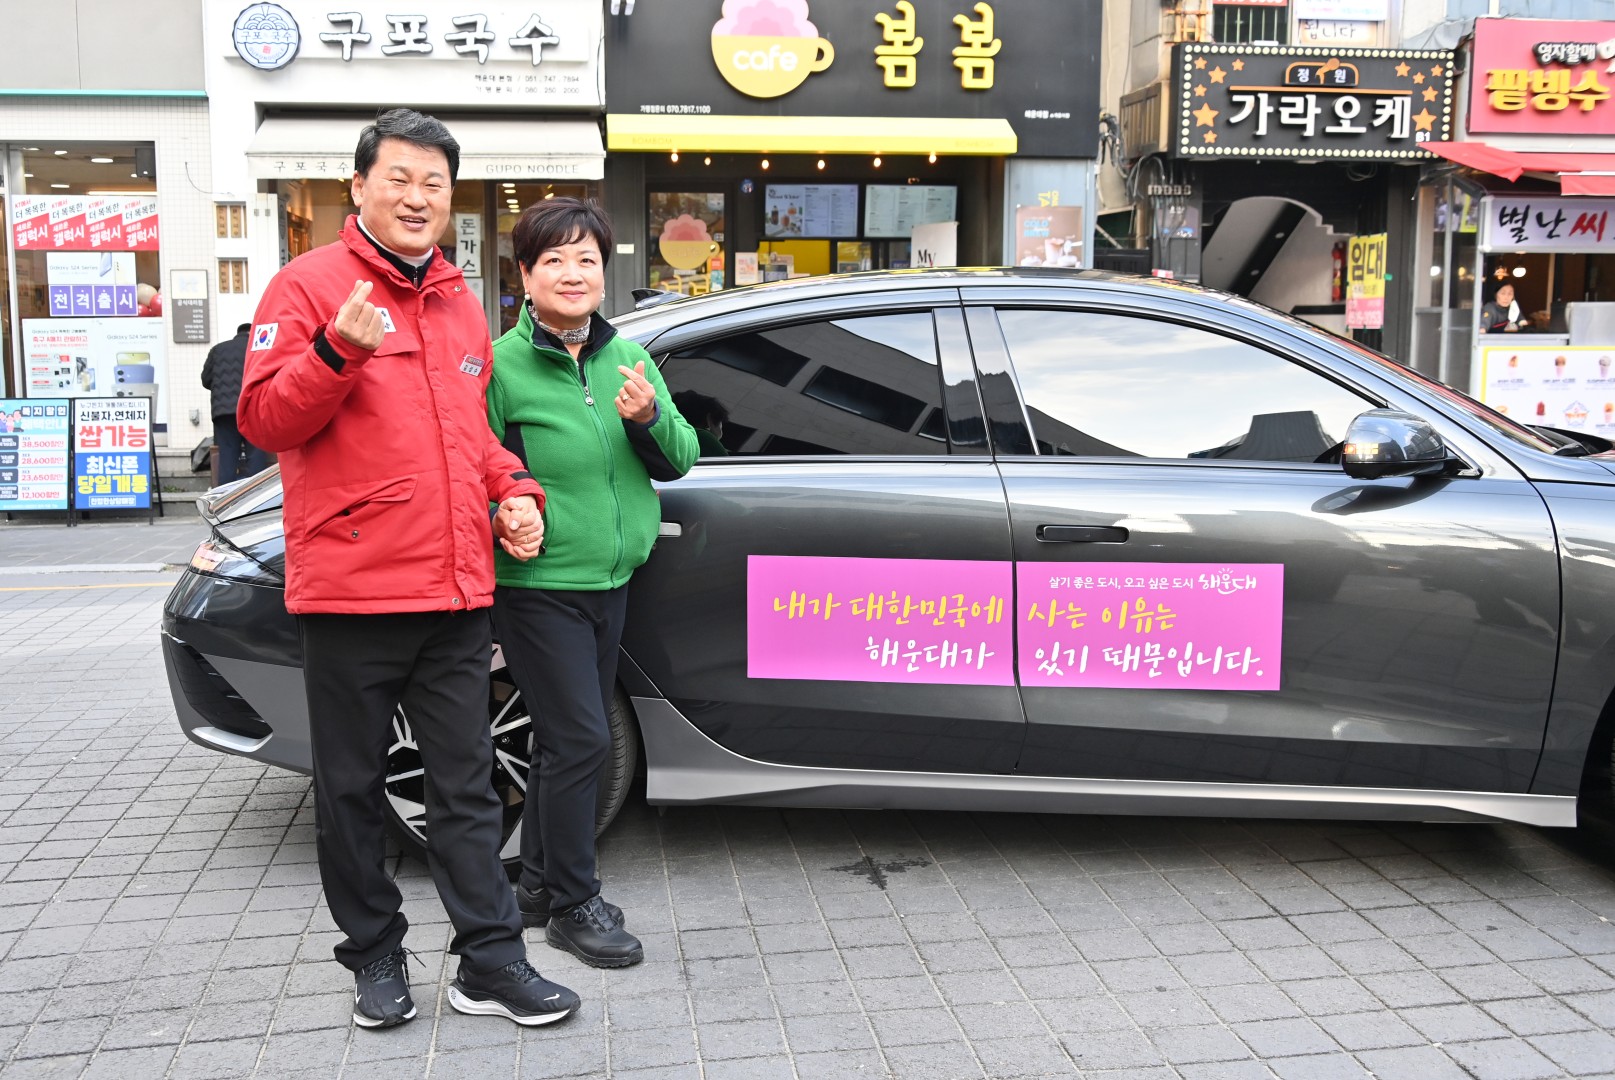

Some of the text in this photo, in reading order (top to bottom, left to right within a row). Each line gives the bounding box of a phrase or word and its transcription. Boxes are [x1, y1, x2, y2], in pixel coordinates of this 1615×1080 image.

[319, 12, 560, 66] 구포국수
[873, 2, 1002, 89] 봄봄
[732, 44, 798, 71] cafe
[1536, 43, 1597, 63] 영자할매
[1485, 69, 1611, 111] 팥빙수
[1229, 93, 1431, 142] 가라오케 B1
[274, 161, 349, 174] 구포국수
[486, 164, 579, 174] GUPO NOODLE
[17, 224, 48, 247] 갤럭시
[54, 224, 85, 247] 갤럭시
[1498, 204, 1615, 243] 별난 씨
[91, 225, 122, 248] 갤럭시
[127, 225, 158, 248] 갤럭시
[460, 218, 477, 272] 돈가스
[1351, 240, 1385, 281] 임대
[54, 291, 134, 309] 전격출시
[79, 425, 147, 448] 쌉가능
[86, 455, 139, 474] 최신폰
[77, 474, 148, 494] 당일개통
[1049, 571, 1257, 595] 살기 좋은 도시, 오고 싶은 도시 해운대
[773, 590, 1003, 628] 내가 대한민국에
[1027, 597, 1177, 634] 사는 이유는
[865, 636, 995, 673] 해운대가
[1035, 641, 1264, 678] 있기 때문입니다.
